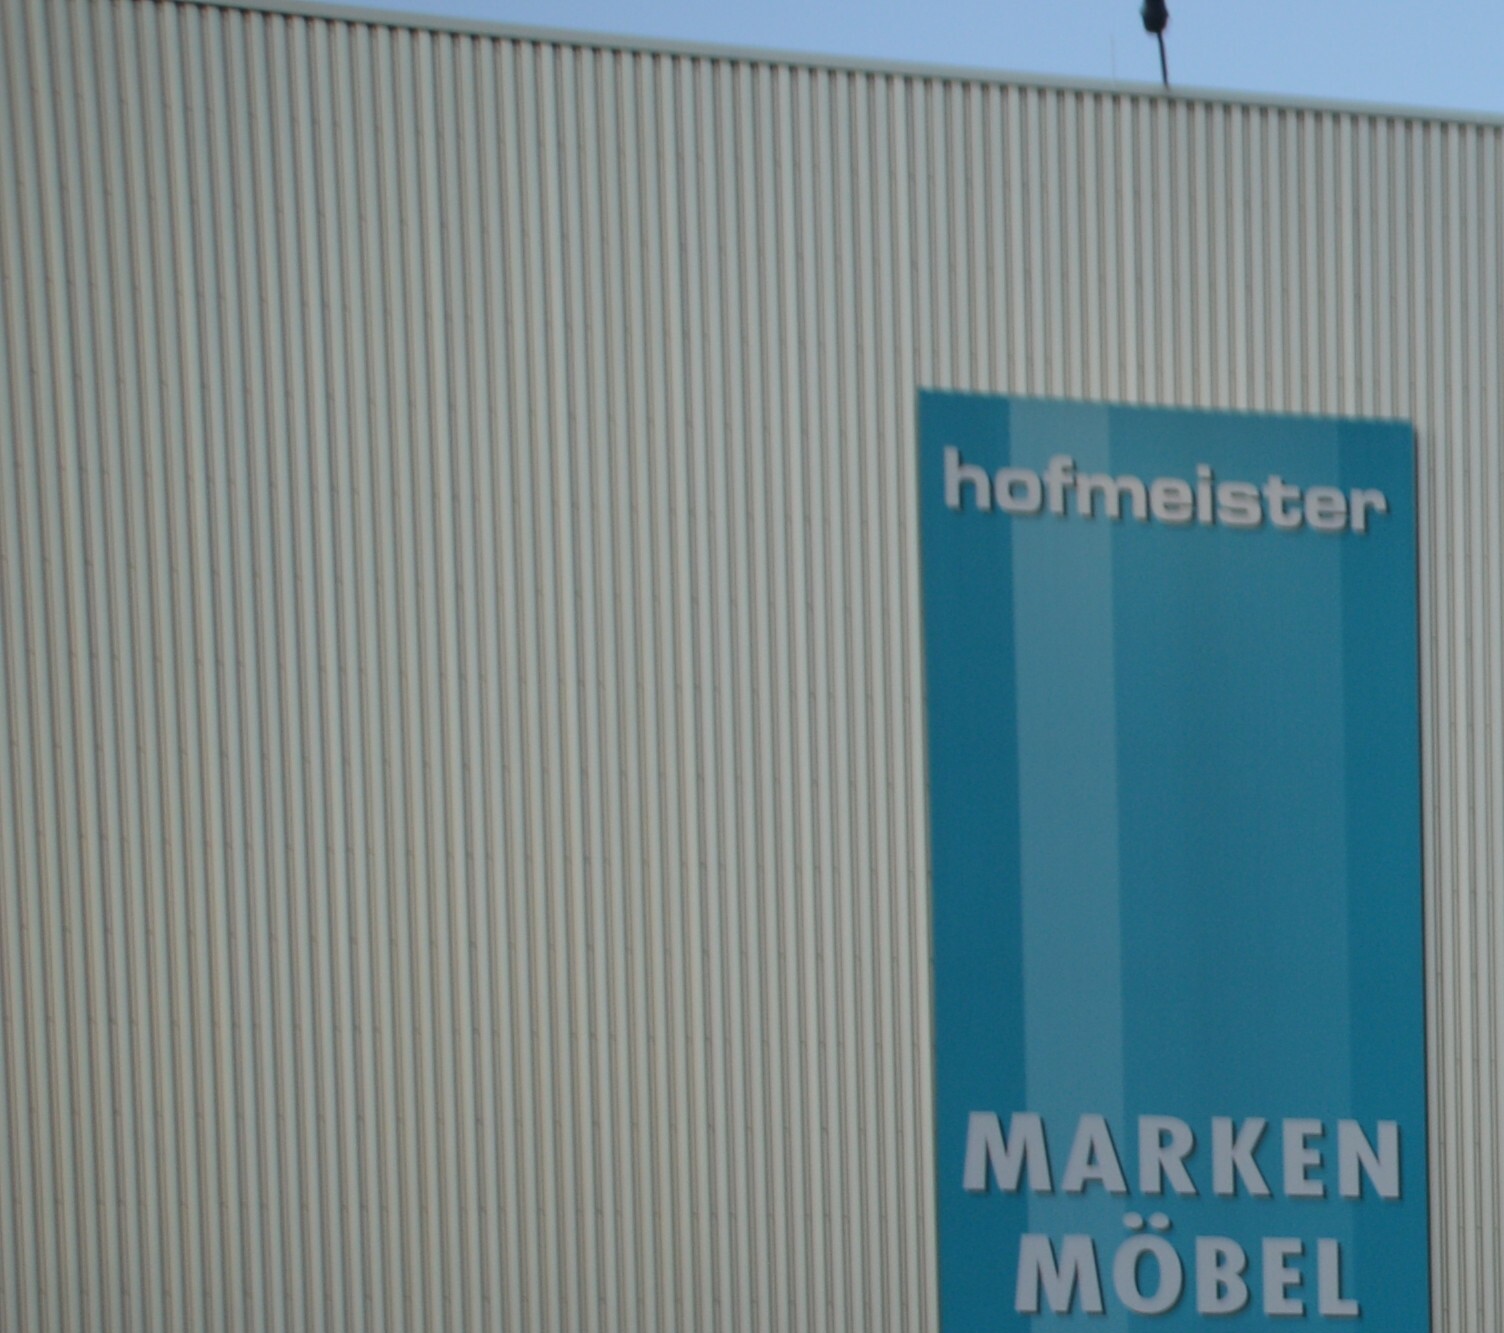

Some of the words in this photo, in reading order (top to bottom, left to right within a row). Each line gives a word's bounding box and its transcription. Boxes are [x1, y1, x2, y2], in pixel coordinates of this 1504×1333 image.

[943, 445, 1389, 533] hofmeister
[962, 1110, 1401, 1200] MARKEN
[1013, 1211, 1361, 1318] MÖBEL
